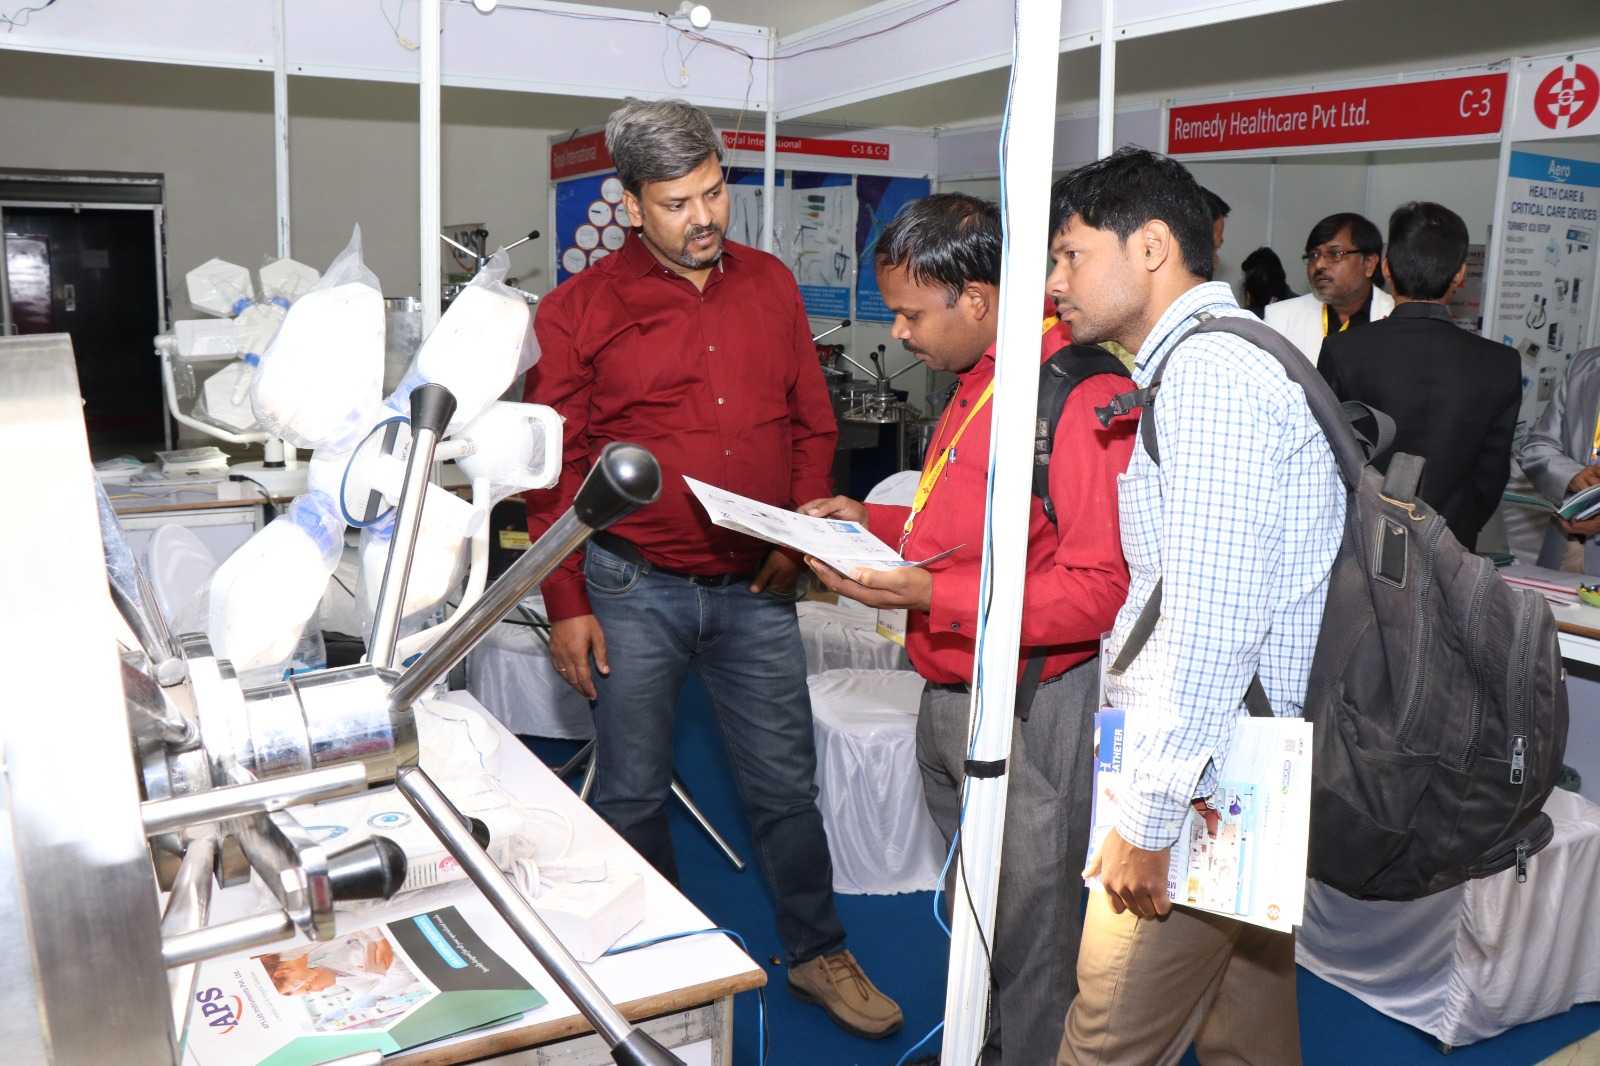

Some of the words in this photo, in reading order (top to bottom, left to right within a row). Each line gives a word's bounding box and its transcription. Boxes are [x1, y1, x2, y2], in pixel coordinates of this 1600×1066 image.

[1459, 87, 1492, 118] C-3
[1174, 112, 1227, 143] Remedy
[1230, 106, 1307, 136] Healthcare
[1312, 103, 1337, 129] Pvt
[1341, 98, 1370, 127] Ltd.
[1529, 184, 1558, 199] HEALTH
[1511, 201, 1545, 216] CRITICAL
[196, 987, 239, 1027] APS
